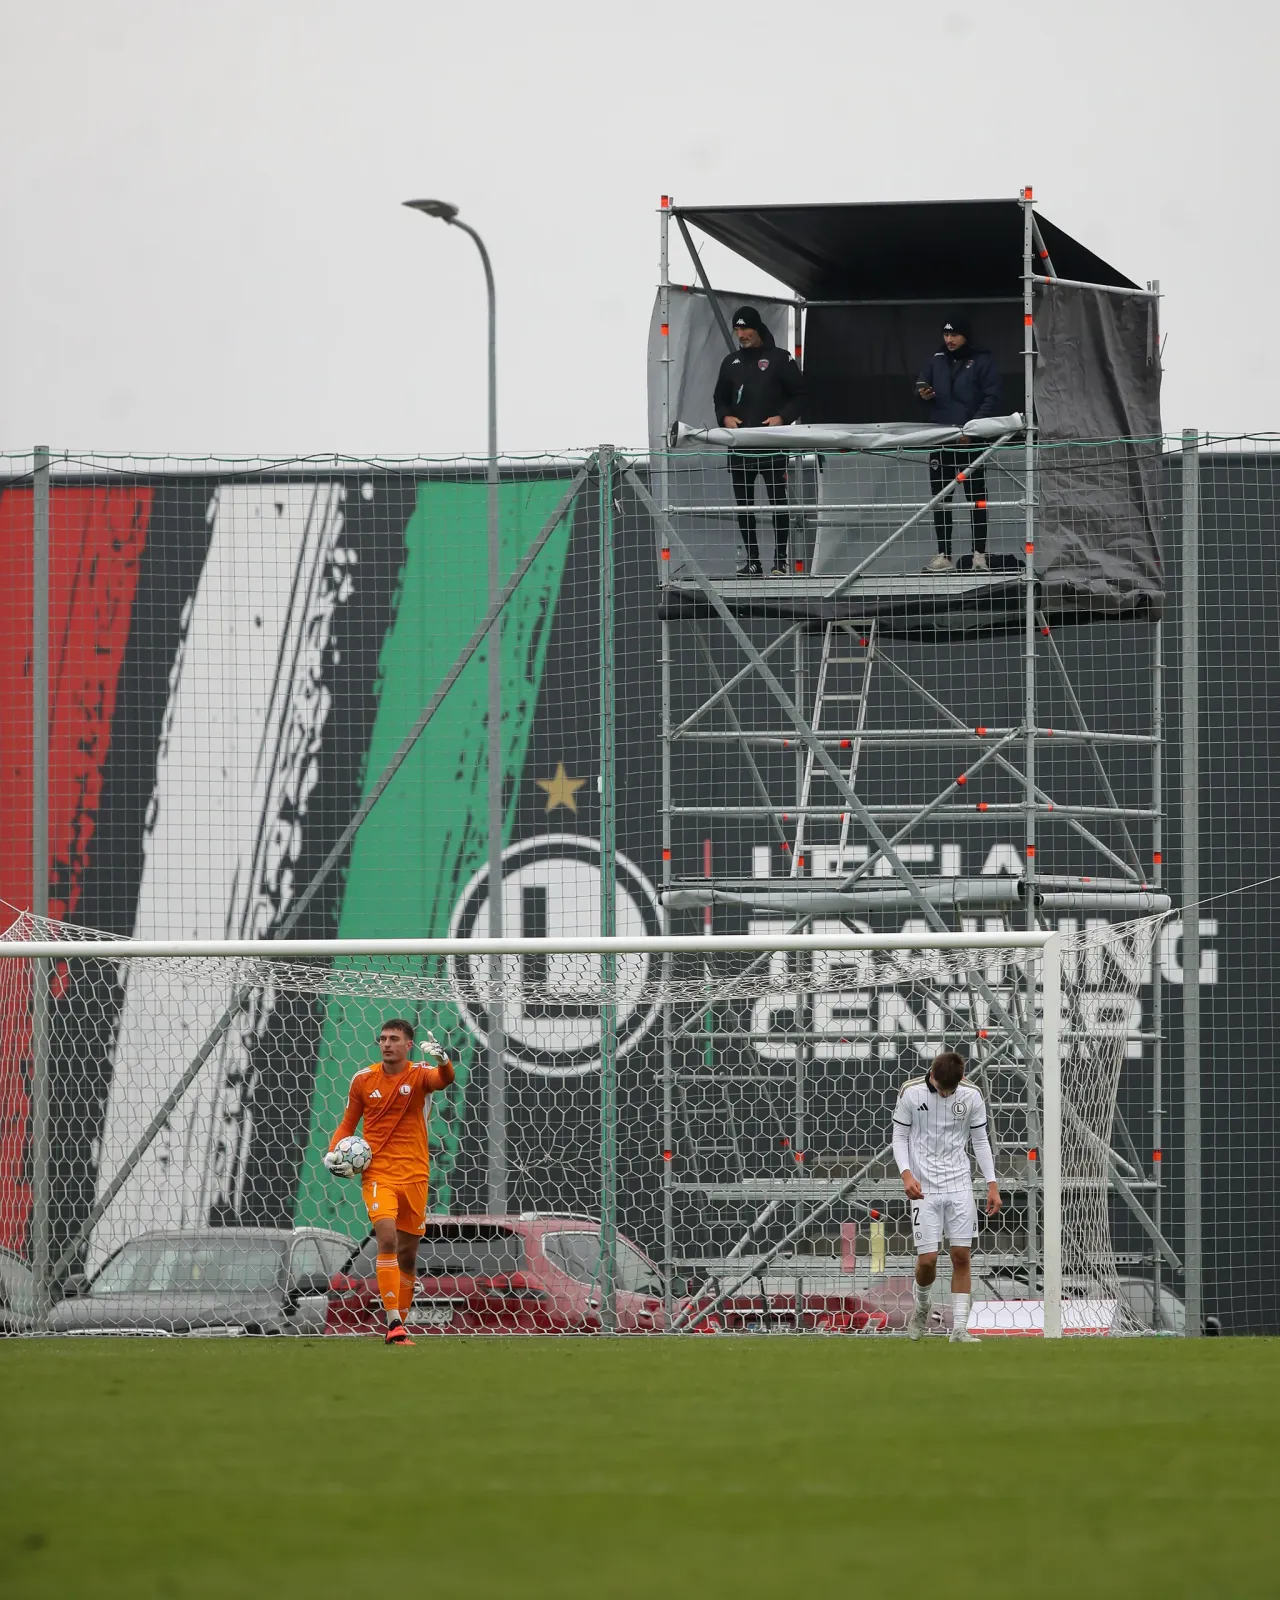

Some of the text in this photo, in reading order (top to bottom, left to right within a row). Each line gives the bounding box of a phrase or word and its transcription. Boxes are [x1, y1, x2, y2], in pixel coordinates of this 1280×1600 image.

[523, 887, 611, 1018] L
[748, 919, 1218, 985] TRAINING
[751, 992, 1142, 1060] CENTER
[913, 1207, 920, 1226] 2
